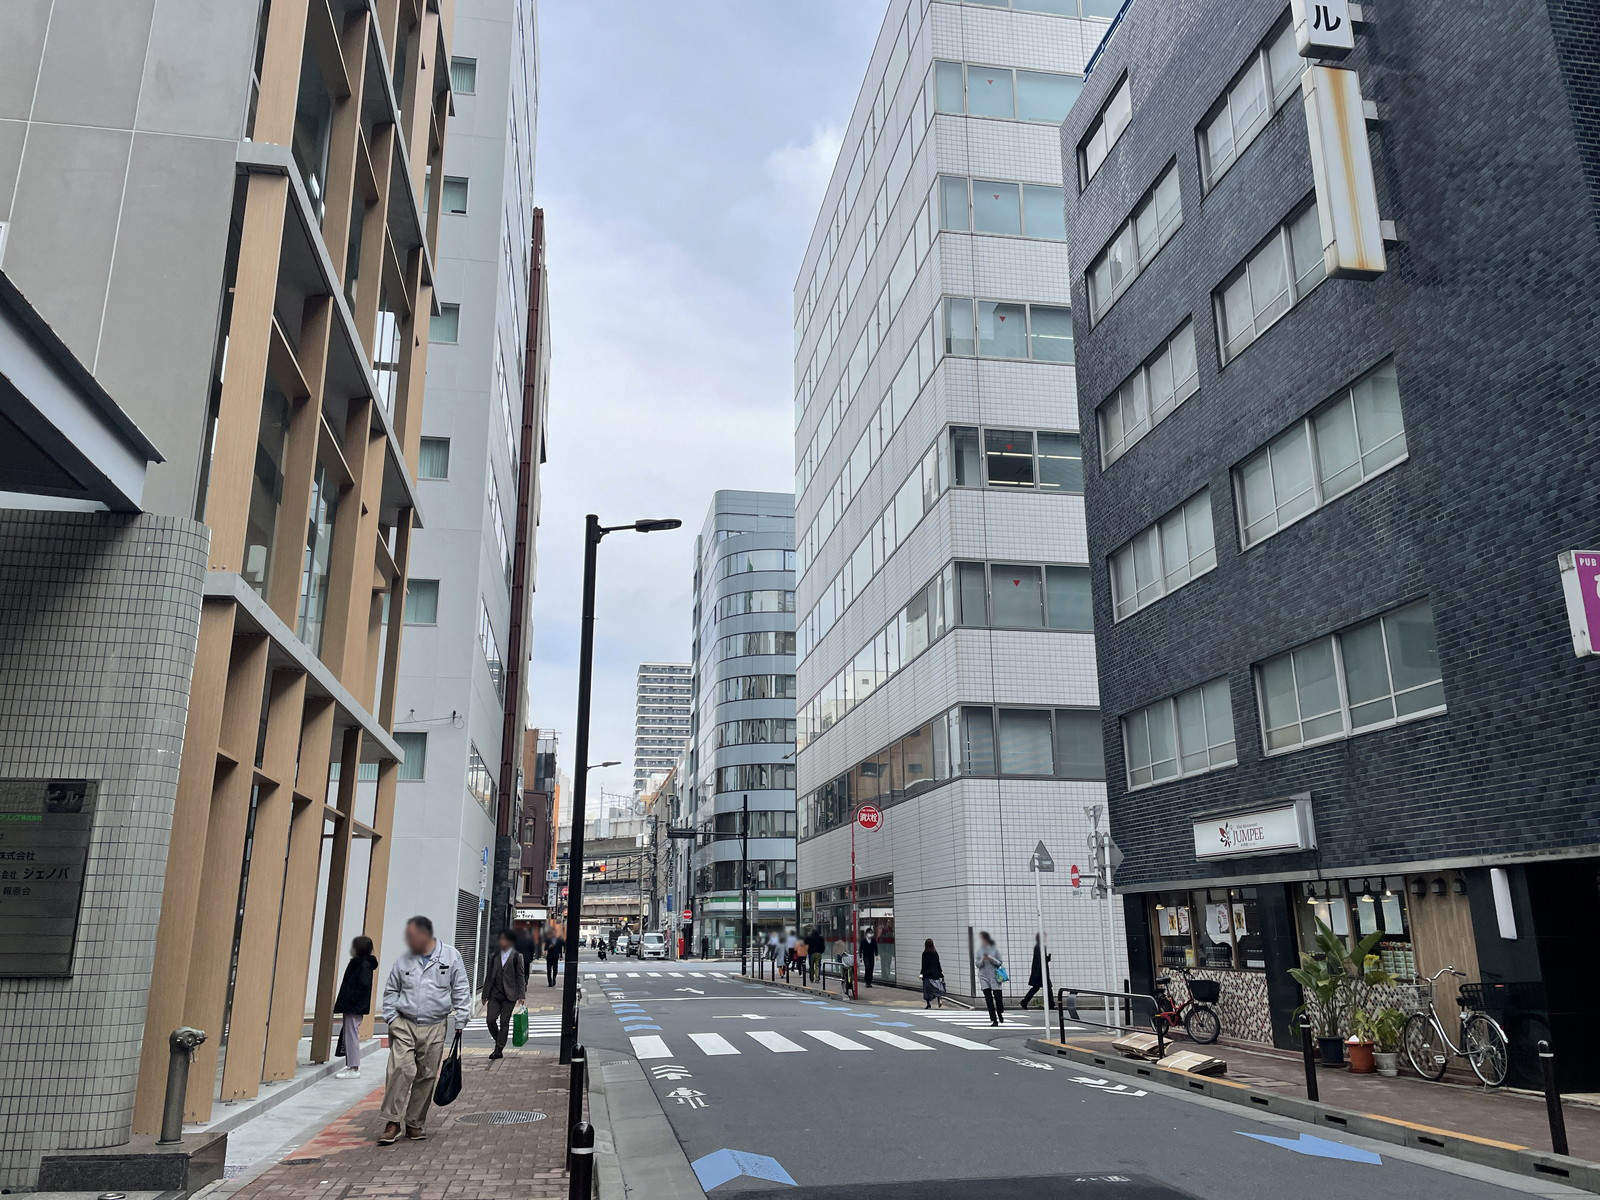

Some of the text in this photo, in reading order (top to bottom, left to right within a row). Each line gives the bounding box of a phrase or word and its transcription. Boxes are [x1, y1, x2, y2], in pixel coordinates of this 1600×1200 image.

[1313, 5, 1341, 32] ル
[1579, 558, 1597, 566] PUB
[860, 812, 878, 823] 消火栓
[1233, 827, 1264, 845] JUMPEE
[0, 870, 17, 880] 会社
